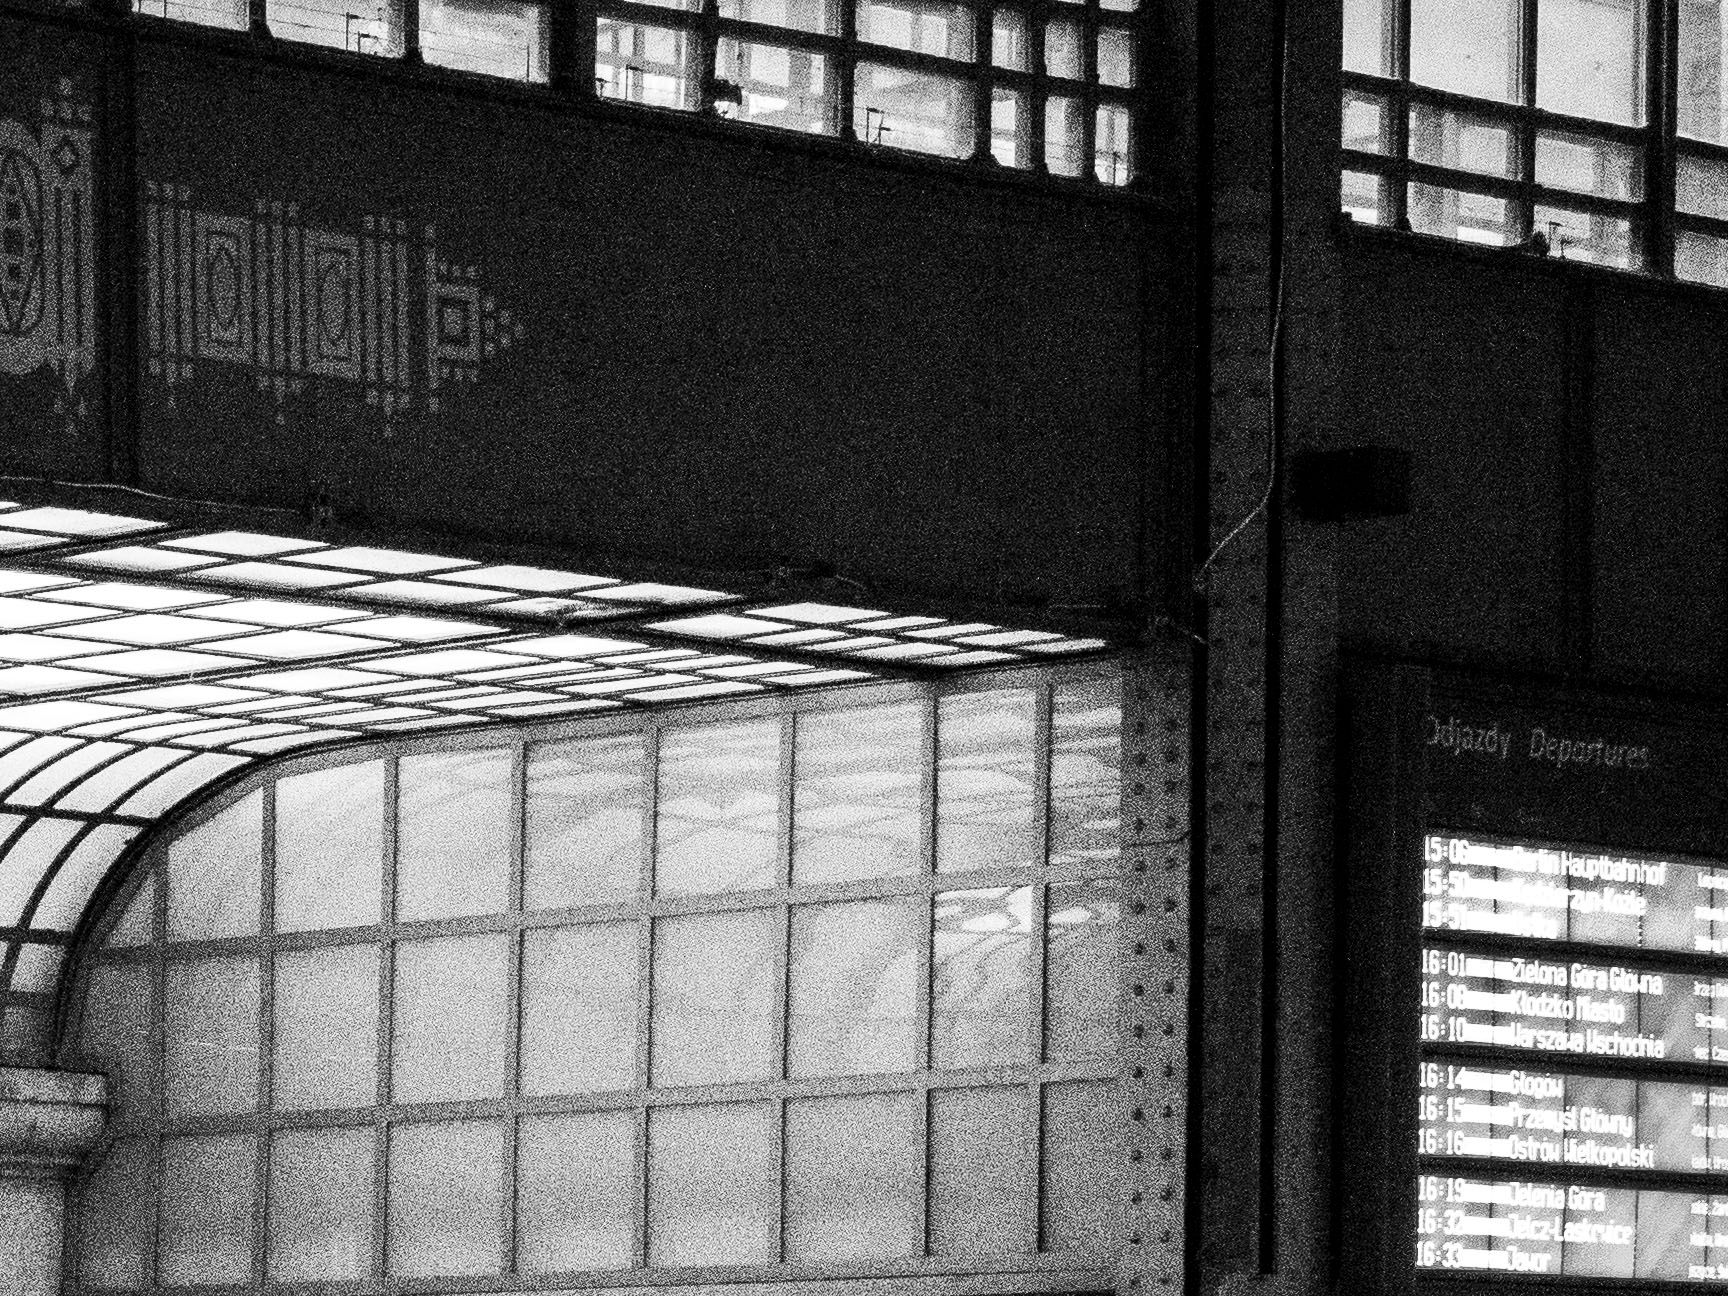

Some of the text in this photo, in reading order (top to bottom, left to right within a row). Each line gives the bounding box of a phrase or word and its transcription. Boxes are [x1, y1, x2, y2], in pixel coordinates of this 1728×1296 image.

[1528, 727, 1650, 769] Departures
[1561, 852, 1666, 886] Hauptbahnhof
[1423, 950, 1466, 977] 16:01
[1512, 959, 1567, 986] Zielona
[1511, 989, 1573, 1019] Kłodzko
[1576, 995, 1626, 1024] Miasto
[1421, 1015, 1466, 1041] 16:10
[1511, 1022, 1584, 1052] Warszawa
[1586, 1029, 1665, 1058] Wschodnia
[1420, 1063, 1466, 1089] 16:14
[1420, 1095, 1634, 1138] 16:15 Przemyśl Główny
[1419, 1128, 1655, 1168] 16:16 Ostrów Wielkopolski
[1419, 1177, 1465, 1203] 16:19
[1509, 1183, 1565, 1209] Jelenia
[1506, 1246, 1551, 1272] Jawor
